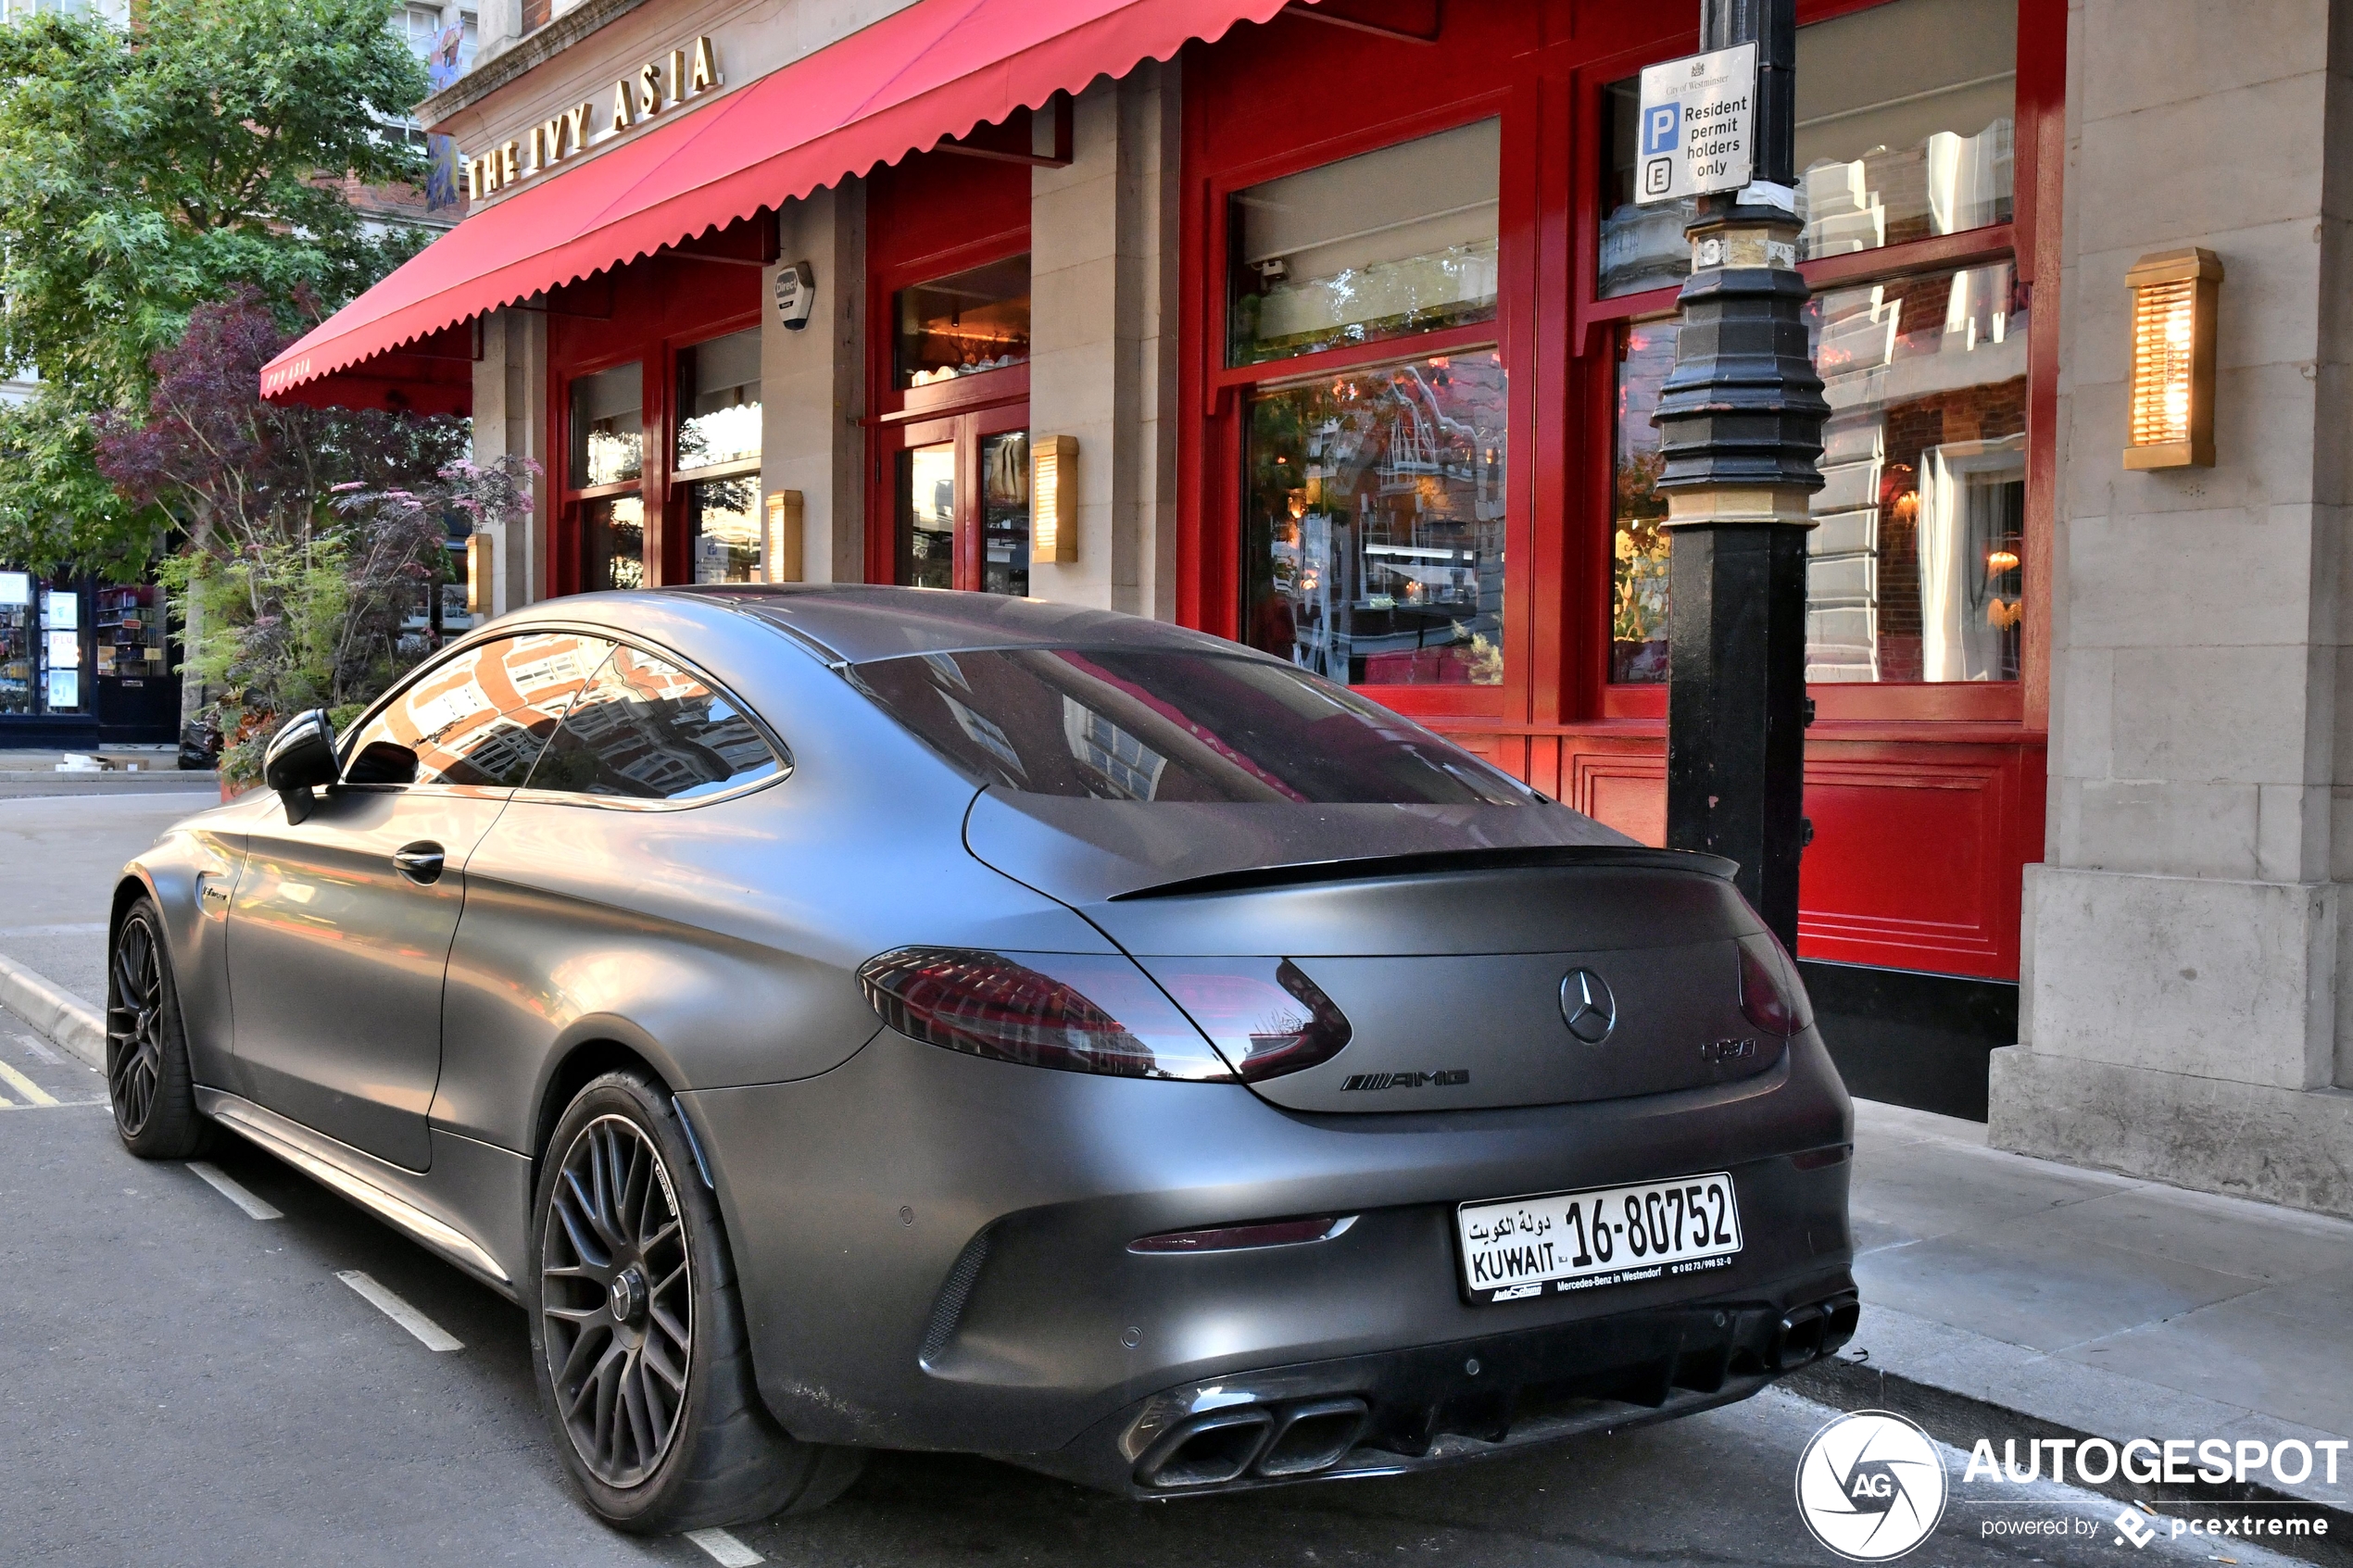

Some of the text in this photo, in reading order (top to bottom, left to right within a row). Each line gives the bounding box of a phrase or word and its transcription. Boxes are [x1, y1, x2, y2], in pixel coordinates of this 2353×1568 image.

[1666, 75, 1729, 97] City of Westminster
[466, 35, 718, 201] THE IVY ASIA
[1684, 96, 1747, 121] Resident
[1651, 109, 1675, 150] P
[1691, 118, 1738, 142] permit
[1687, 139, 1740, 159] holders
[1654, 168, 1664, 186] E
[1697, 160, 1728, 177] only
[776, 278, 797, 294] Direct
[288, 358, 310, 381] ASIA
[53, 635, 73, 645] FLU
[1387, 1070, 1470, 1088] AMG
[1468, 1210, 1552, 1246] دولة الكويت
[1565, 1184, 1731, 1268] 16-80752
[1472, 1242, 1554, 1283] KUWAIT
[1557, 1275, 1612, 1291] Mercedes-Benz
[1614, 1273, 1621, 1283] in
[1622, 1266, 1662, 1282] Westendorf
